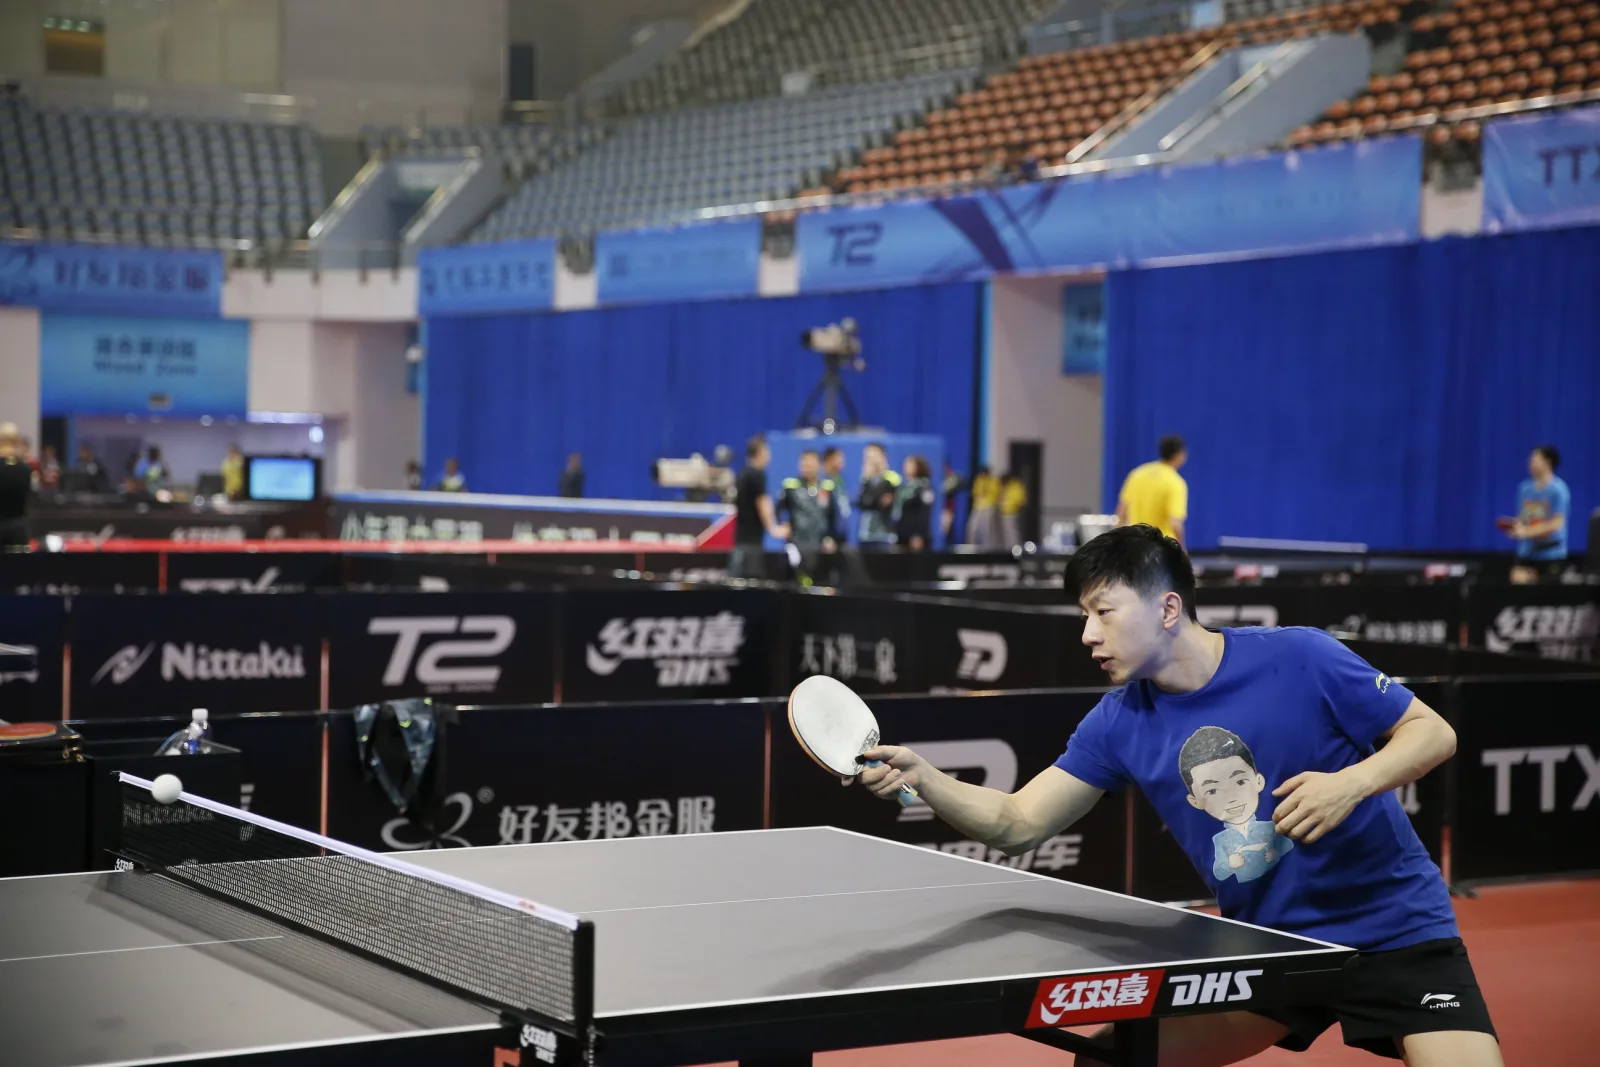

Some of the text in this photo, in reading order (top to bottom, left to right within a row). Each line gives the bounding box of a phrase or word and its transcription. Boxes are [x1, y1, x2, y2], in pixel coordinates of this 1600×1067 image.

[1538, 142, 1600, 187] TT
[825, 222, 883, 267] T2
[366, 614, 517, 686] T2
[586, 611, 747, 676] 红双喜
[654, 658, 740, 687] DHS
[498, 795, 716, 846] 好友邦金服
[1040, 972, 1150, 1025] 红双喜
[1168, 969, 1264, 1007] DHS
